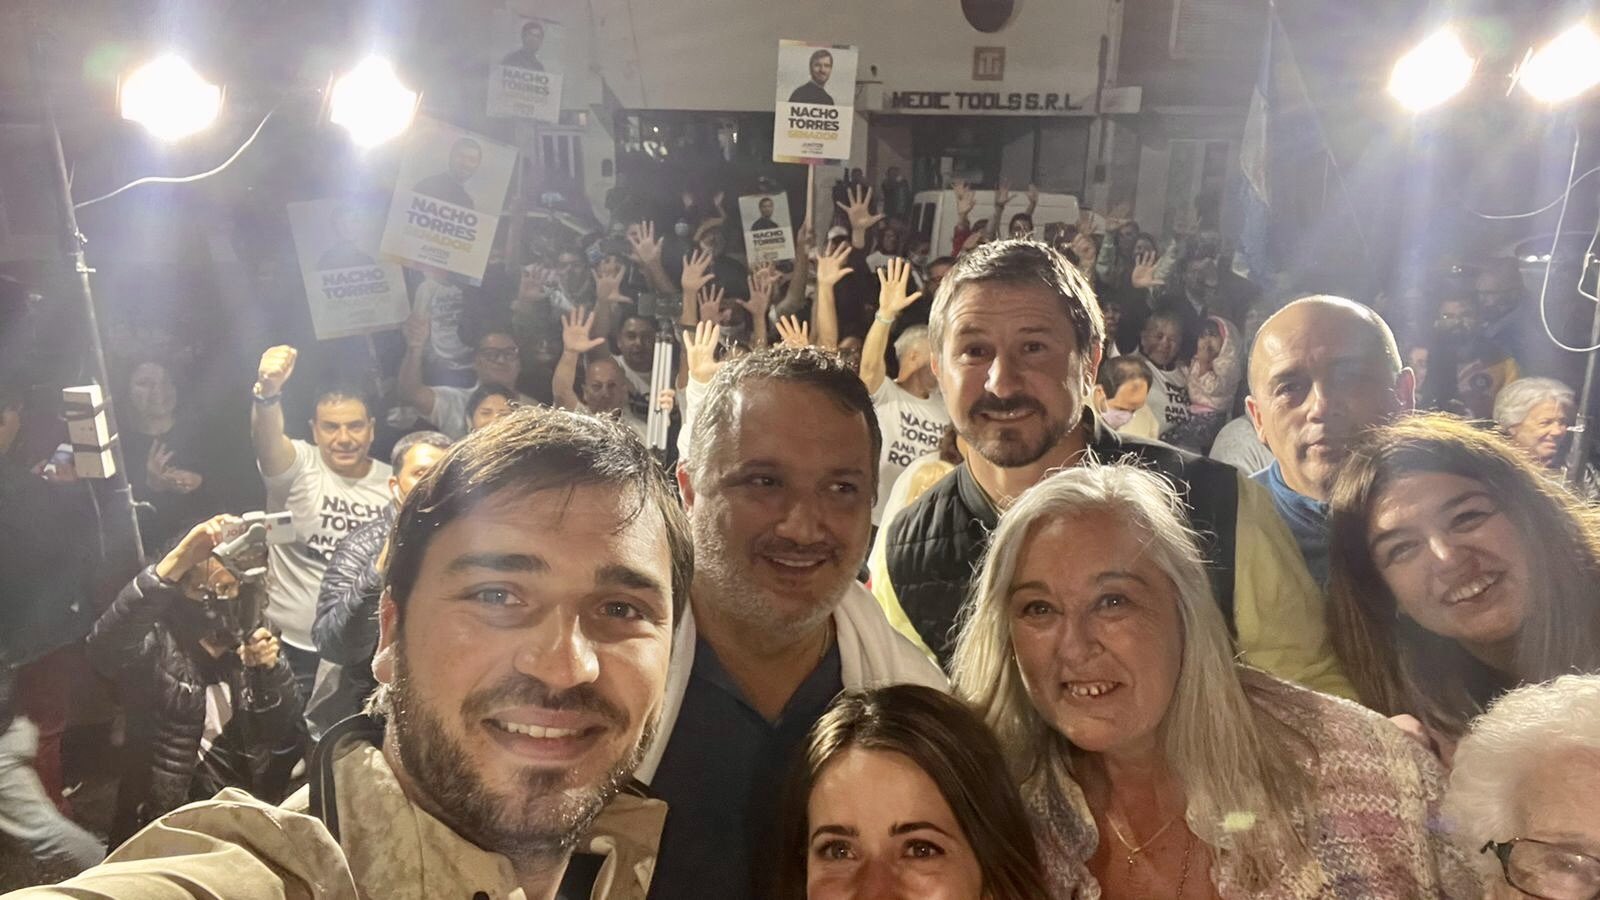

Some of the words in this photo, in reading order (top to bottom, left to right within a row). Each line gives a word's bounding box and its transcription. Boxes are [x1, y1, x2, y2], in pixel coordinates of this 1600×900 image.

[502, 68, 549, 86] NACHO
[892, 91, 950, 109] MEDIC
[955, 92, 1022, 110] TOOLS
[790, 106, 839, 120] NACHO
[788, 118, 840, 132] TORRES
[410, 195, 478, 228] NACHO
[406, 210, 477, 242] TORRES
[752, 230, 784, 239] NACHO
[322, 267, 385, 286] NACHO
[322, 281, 392, 299] TORRES
[900, 425, 943, 447] TORR
[888, 450, 914, 468] RO
